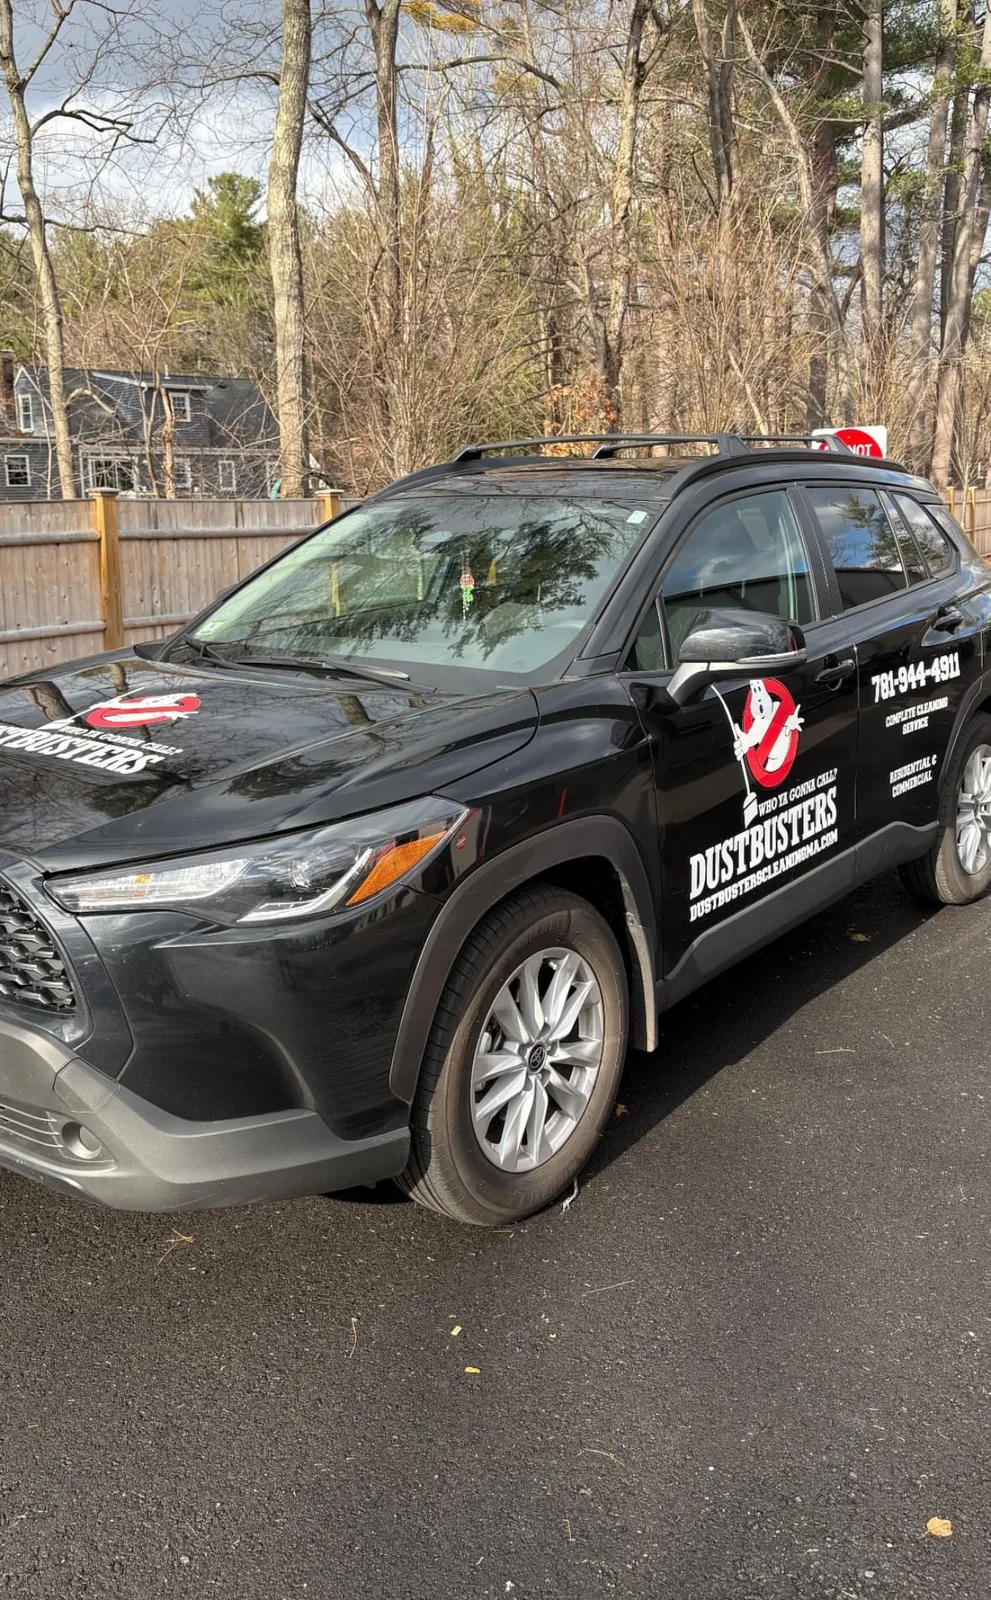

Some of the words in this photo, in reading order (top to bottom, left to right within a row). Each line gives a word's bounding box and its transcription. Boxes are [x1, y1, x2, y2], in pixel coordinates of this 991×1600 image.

[847, 444, 872, 456] NOT
[871, 652, 960, 703] 781-944-4911
[885, 706, 916, 728] COMPLETE
[916, 696, 949, 716] CLEANING
[902, 716, 929, 735] SERVICE
[0, 725, 165, 775] TBUSTERS
[889, 756, 931, 784] RESIDENTIAL
[758, 797, 778, 817] WHO
[778, 791, 788, 807] YA
[789, 778, 816, 802] GONNA
[816, 767, 838, 788] CALL?
[892, 770, 933, 798] COMMERCIAL
[690, 786, 838, 901] DUSTBUSTERS
[690, 828, 838, 923] DUSTBUSTERSCLEANINGMA.COM
